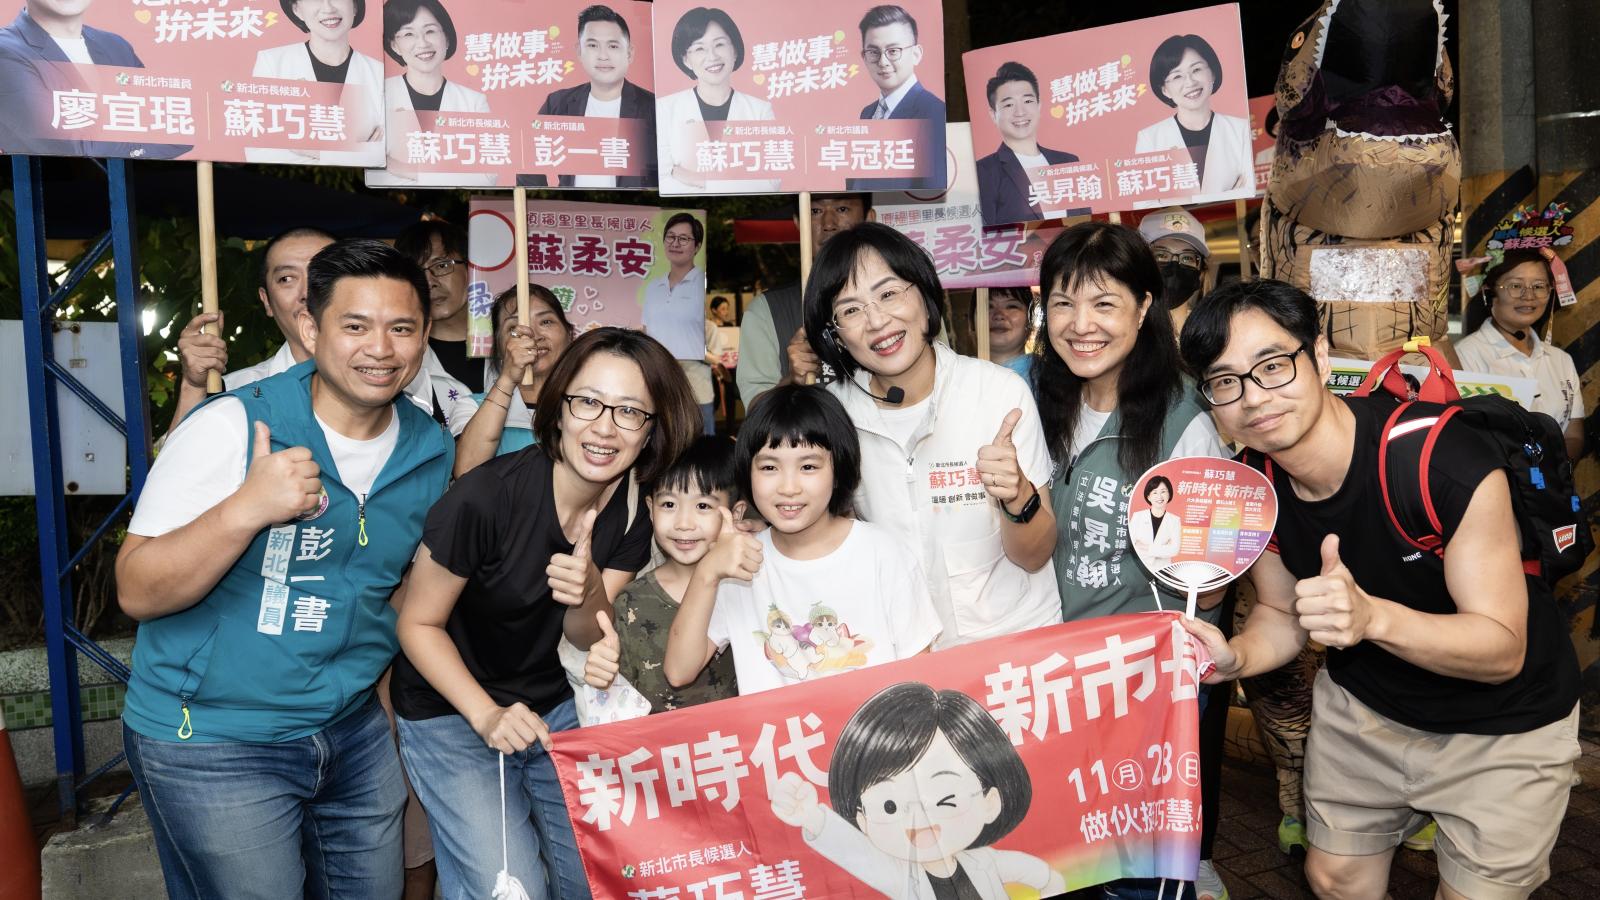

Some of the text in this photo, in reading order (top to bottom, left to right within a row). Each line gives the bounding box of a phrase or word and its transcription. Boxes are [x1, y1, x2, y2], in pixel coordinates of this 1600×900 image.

[155, 6, 264, 43] 拚未來
[464, 29, 549, 62] 慧做事
[751, 35, 834, 71] 慧做事
[133, 75, 192, 90] 新北市議員
[236, 82, 311, 98] 新北市長候選人
[481, 58, 564, 92] 拚未來
[766, 62, 848, 99] 拚未來
[1050, 60, 1122, 103] 慧做事
[51, 88, 195, 135] 廖宜琨
[223, 98, 348, 141] 蘇巧慧
[1066, 84, 1137, 126] 拚未來
[447, 116, 510, 129] 新北市長候選人
[543, 120, 586, 132] 新北市議員
[735, 125, 793, 137] 新北市長候選人
[827, 125, 869, 136] 新北市議員
[406, 130, 512, 166] 蘇巧慧
[533, 135, 630, 169] 彭一書
[695, 139, 795, 173] 蘇巧慧
[817, 139, 916, 171] 卓冠廷
[1028, 175, 1104, 207] 吳昇翰
[1116, 162, 1200, 197] 蘇巧慧
[528, 234, 652, 275] 蘇柔安
[905, 223, 1024, 271] 柔安
[928, 466, 984, 488] 蘇巧慧
[1177, 480, 1267, 500] 新時代 新市長
[1204, 469, 1235, 480] 蘇巧慧
[1076, 476, 1118, 588] 吳昇翰
[291, 526, 335, 632] 彭一書
[576, 712, 830, 832] 新時代
[639, 841, 752, 878] 新北市長候選人
